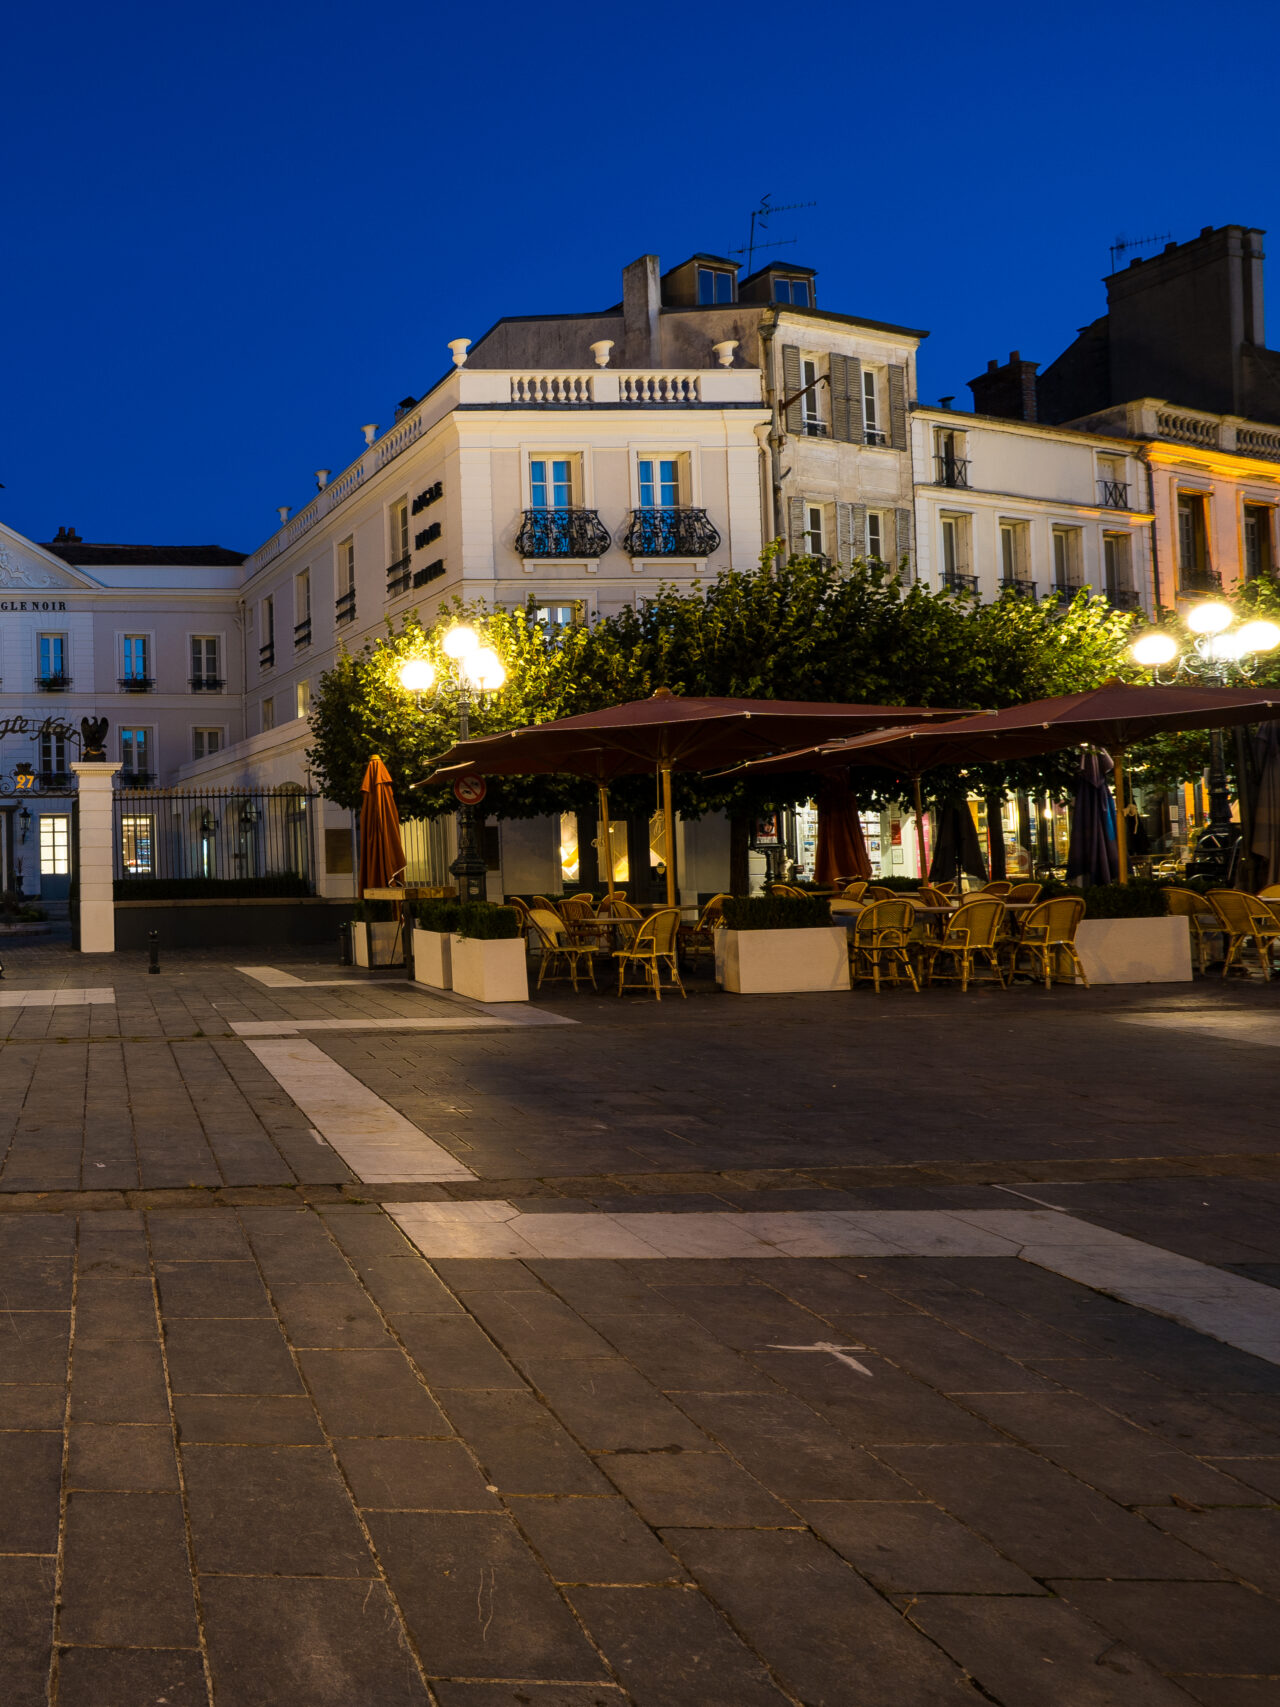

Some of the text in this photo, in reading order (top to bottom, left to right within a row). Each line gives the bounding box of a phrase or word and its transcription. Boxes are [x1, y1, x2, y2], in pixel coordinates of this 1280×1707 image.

[32, 601, 67, 611] NOIR
[30, 715, 80, 743] Noir
[15, 774, 35, 789] 27
